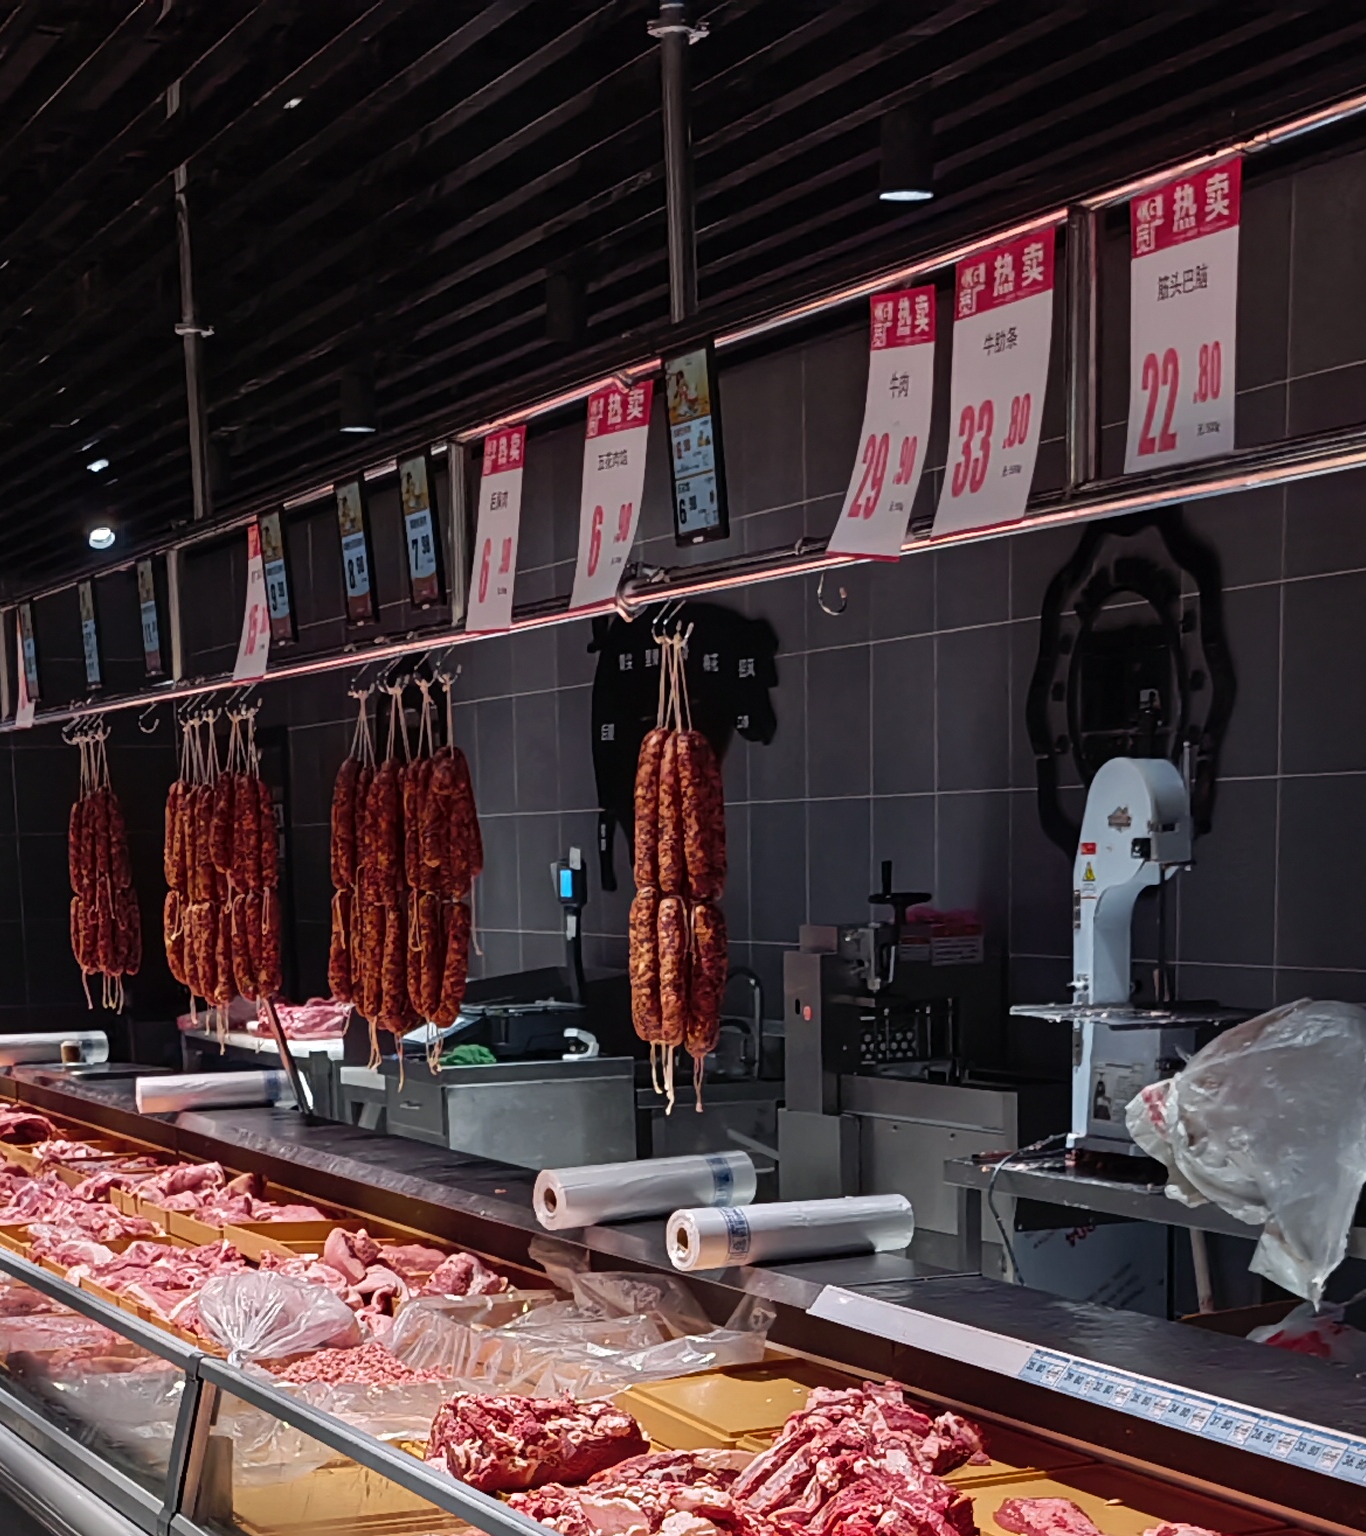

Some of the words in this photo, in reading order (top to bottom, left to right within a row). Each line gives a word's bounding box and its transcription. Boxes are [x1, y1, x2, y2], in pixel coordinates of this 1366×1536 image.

[1172, 172, 1230, 233] 热卖
[993, 242, 1045, 298] 热卖
[1137, 347, 1180, 457] 22
[847, 432, 890, 520] 29
[951, 399, 994, 498] 33
[587, 505, 604, 578] 6
[679, 497, 688, 525] 6
[411, 538, 419, 571] 7
[478, 538, 492, 604] 6
